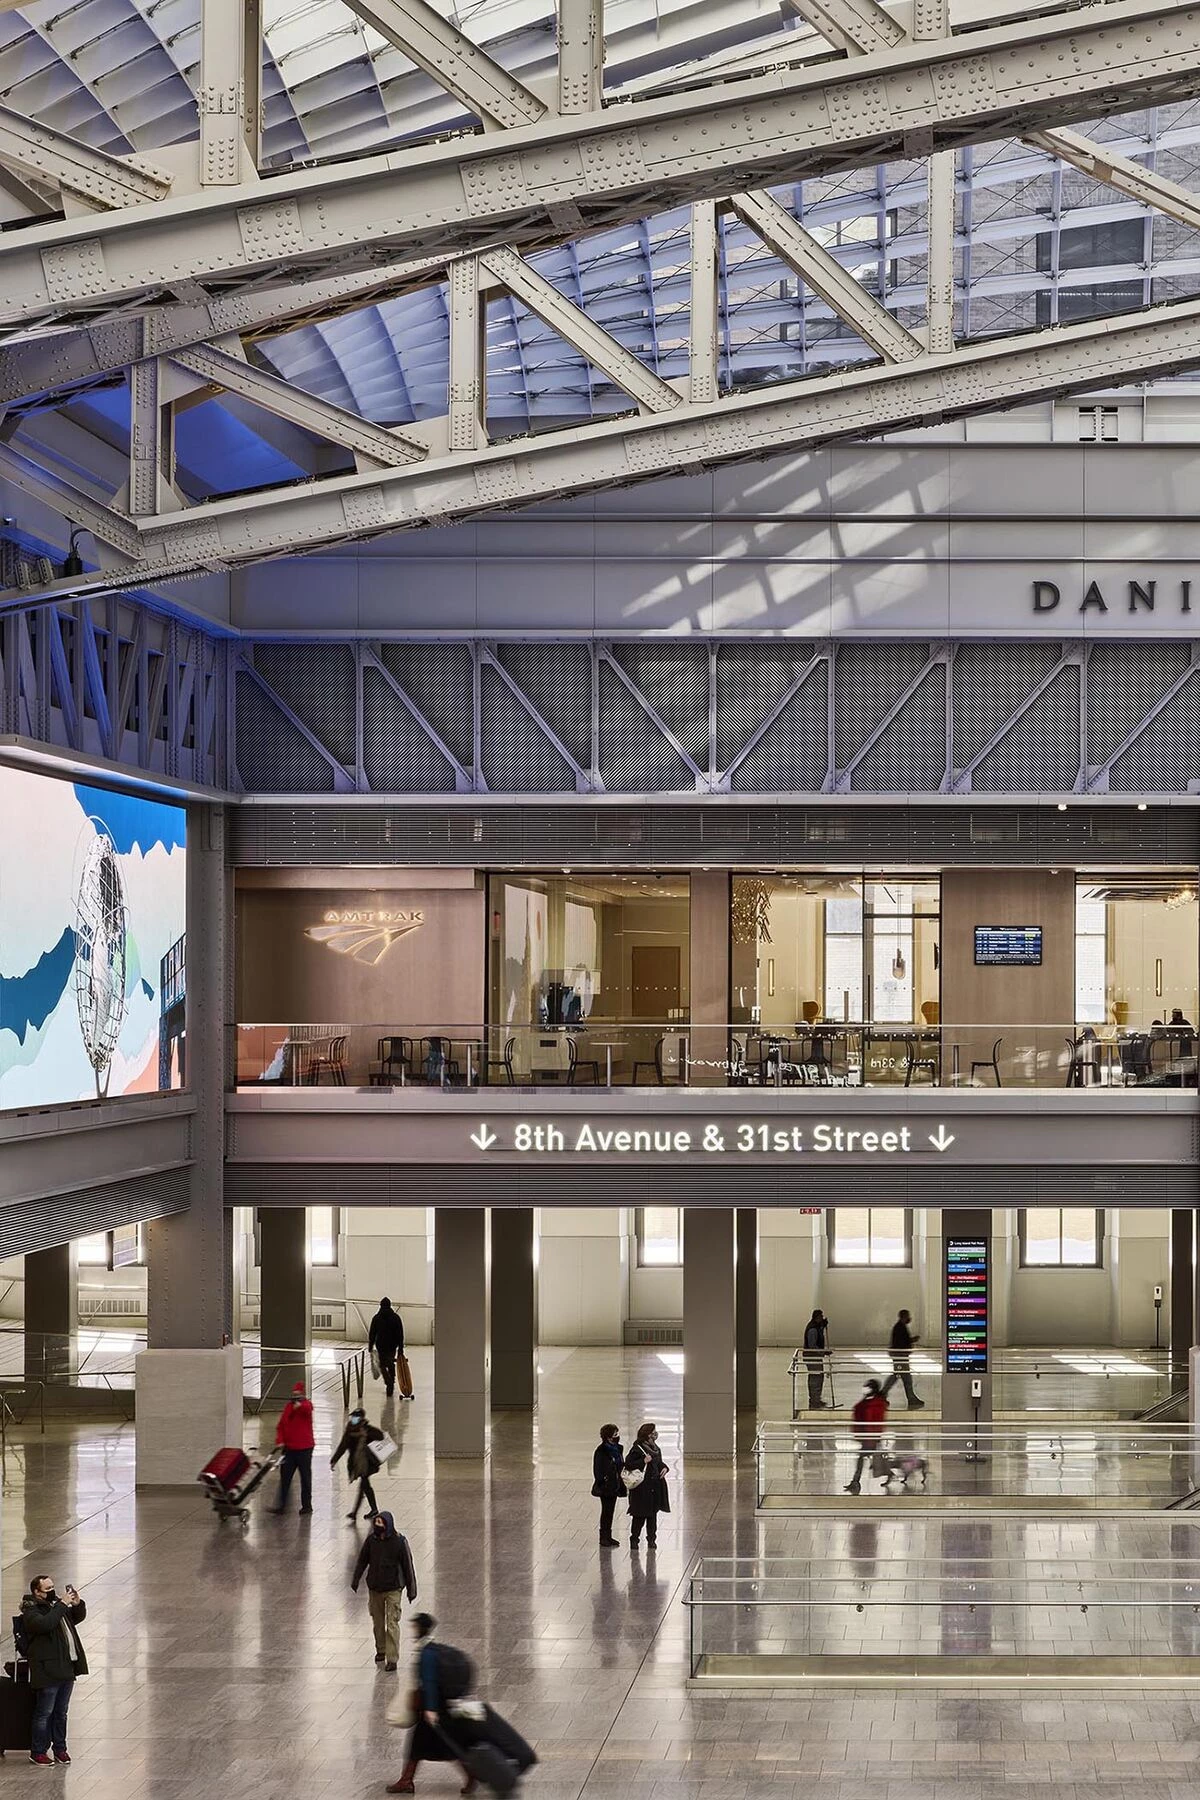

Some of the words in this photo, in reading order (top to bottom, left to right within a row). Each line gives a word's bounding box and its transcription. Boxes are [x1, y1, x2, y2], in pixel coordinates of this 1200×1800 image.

[324, 910, 424, 922] AMTRAK
[514, 1123, 564, 1151] 8th
[574, 1124, 691, 1151] Avenue
[702, 1124, 725, 1151] &
[737, 1124, 802, 1151] 31st
[813, 1124, 911, 1151] Street
